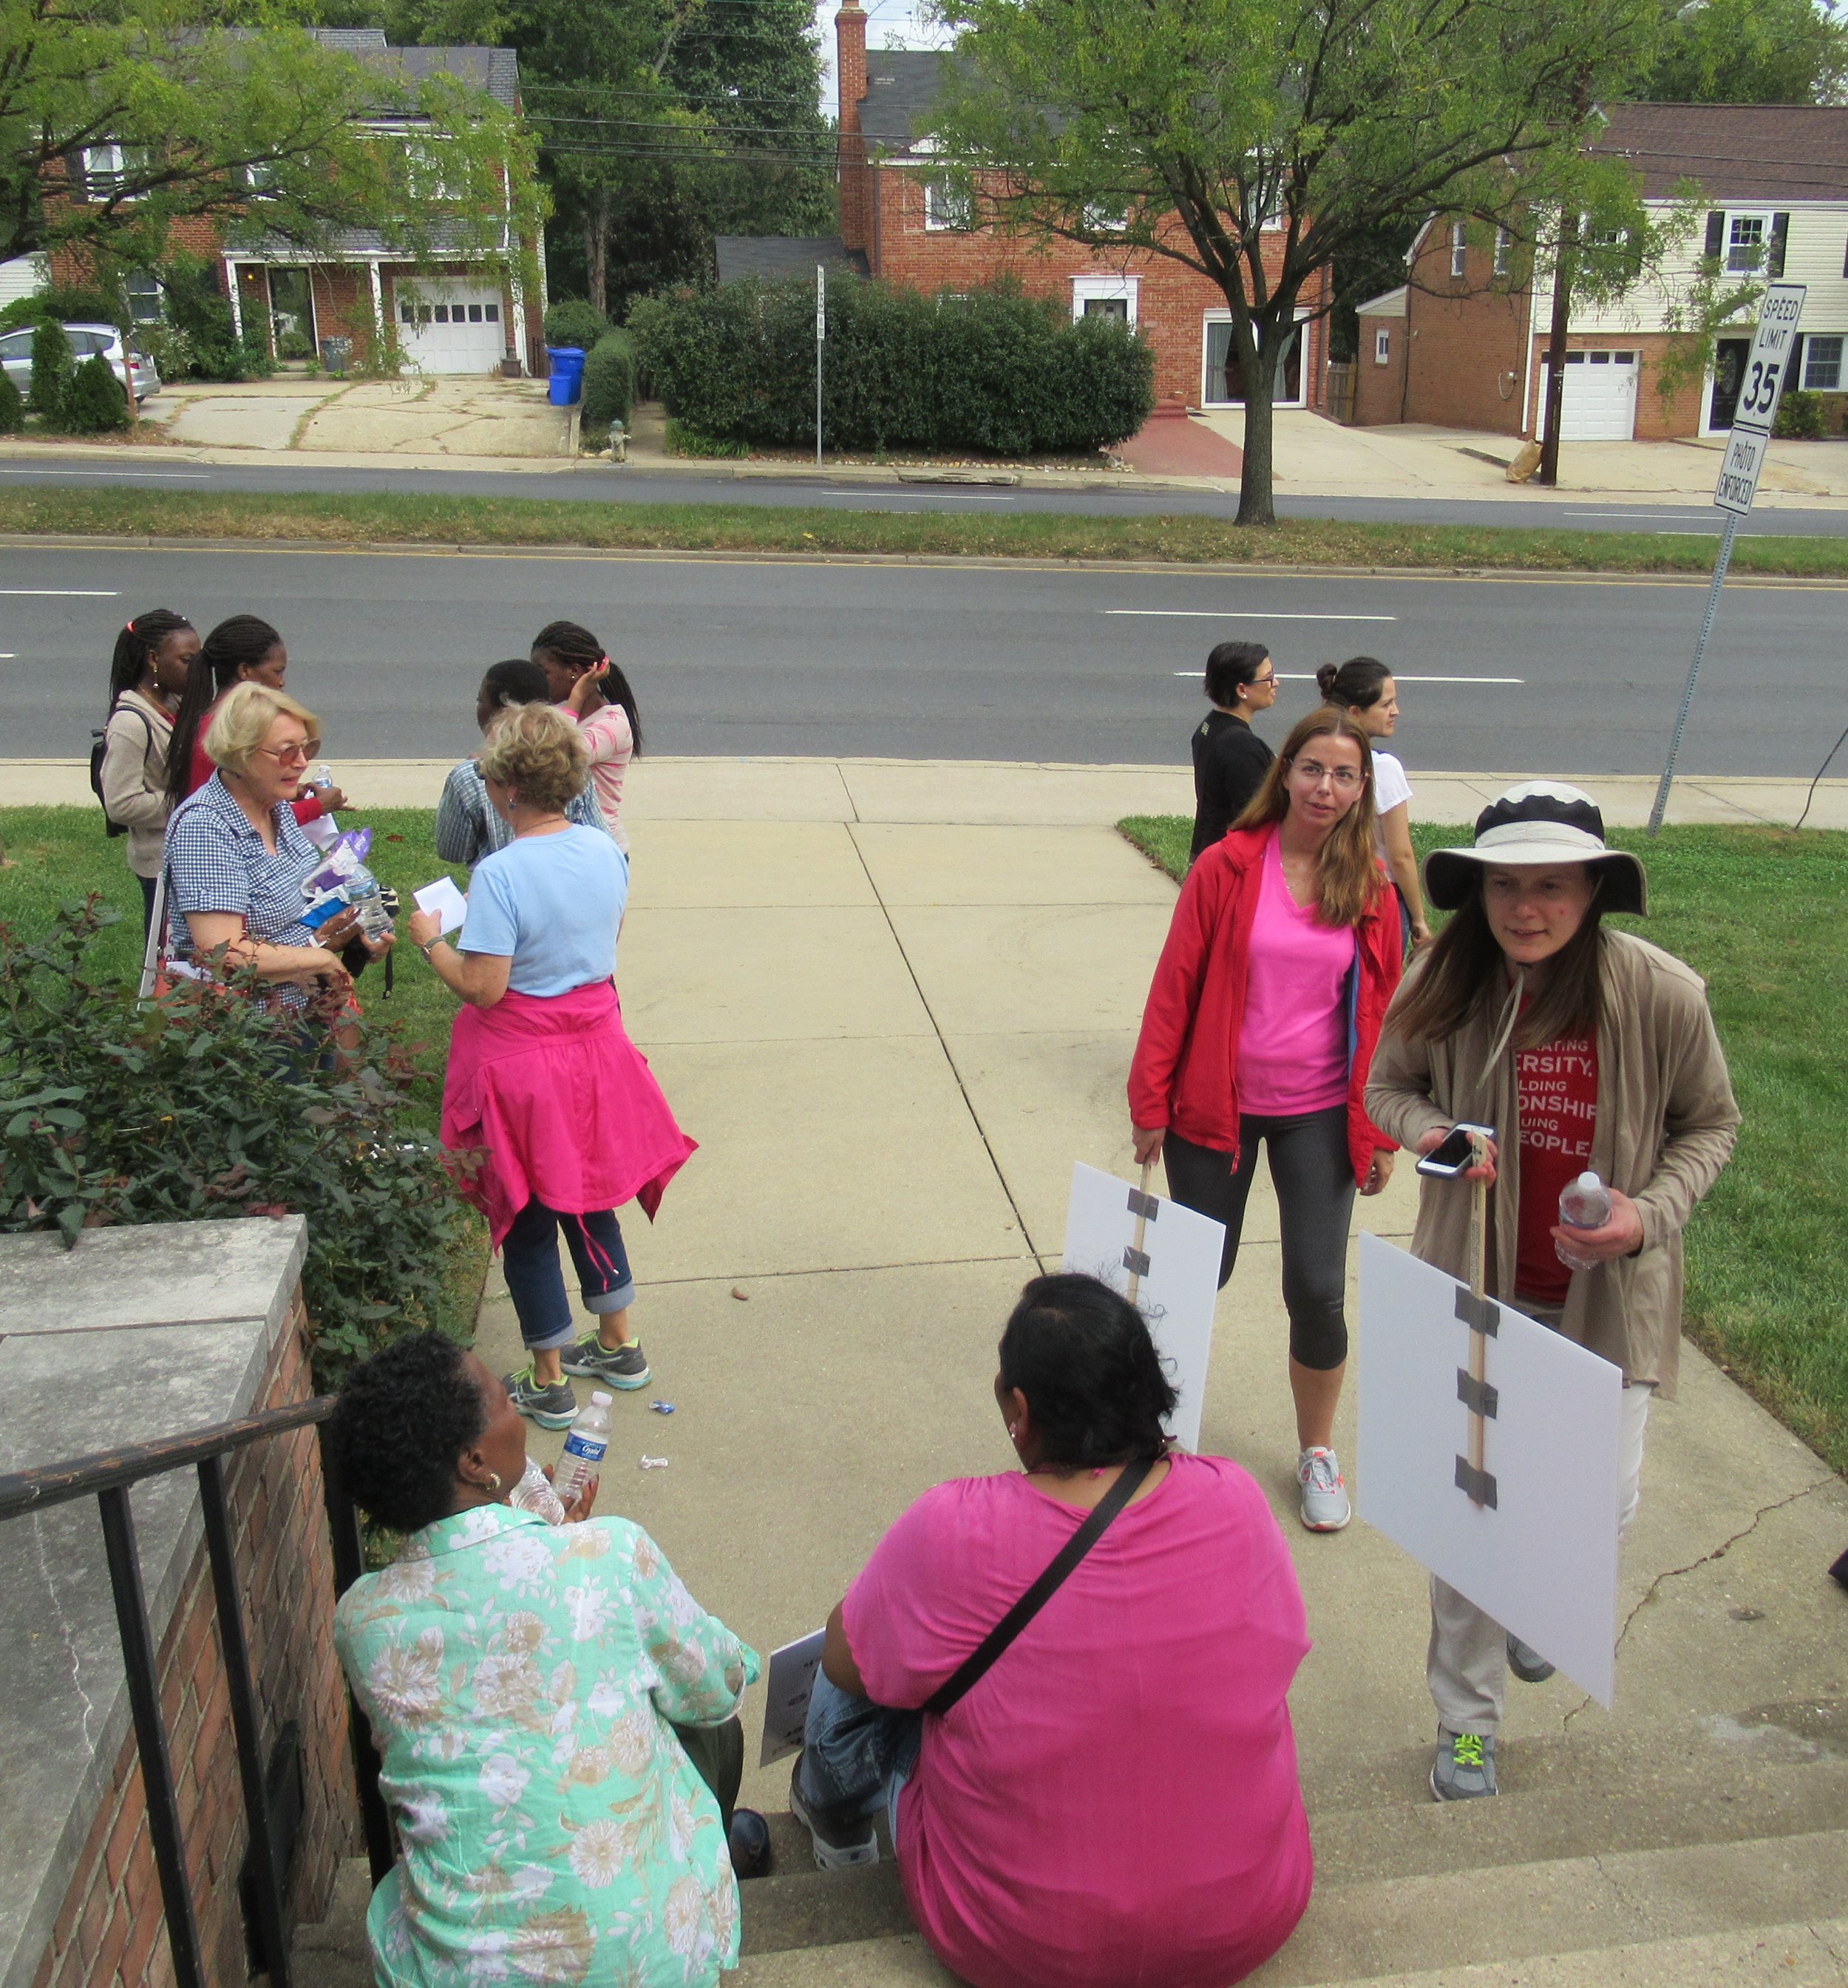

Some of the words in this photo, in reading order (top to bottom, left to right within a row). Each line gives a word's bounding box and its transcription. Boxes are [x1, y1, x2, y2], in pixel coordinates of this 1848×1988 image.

[1764, 299, 1798, 321] SPEED
[1759, 328, 1787, 350] LIMIT
[1743, 361, 1780, 413] 35
[1730, 442, 1756, 472] PHOTO
[1718, 473, 1753, 505] ENFORCED
[1518, 1079, 1567, 1091] LDING
[1521, 1118, 1559, 1131] UING
